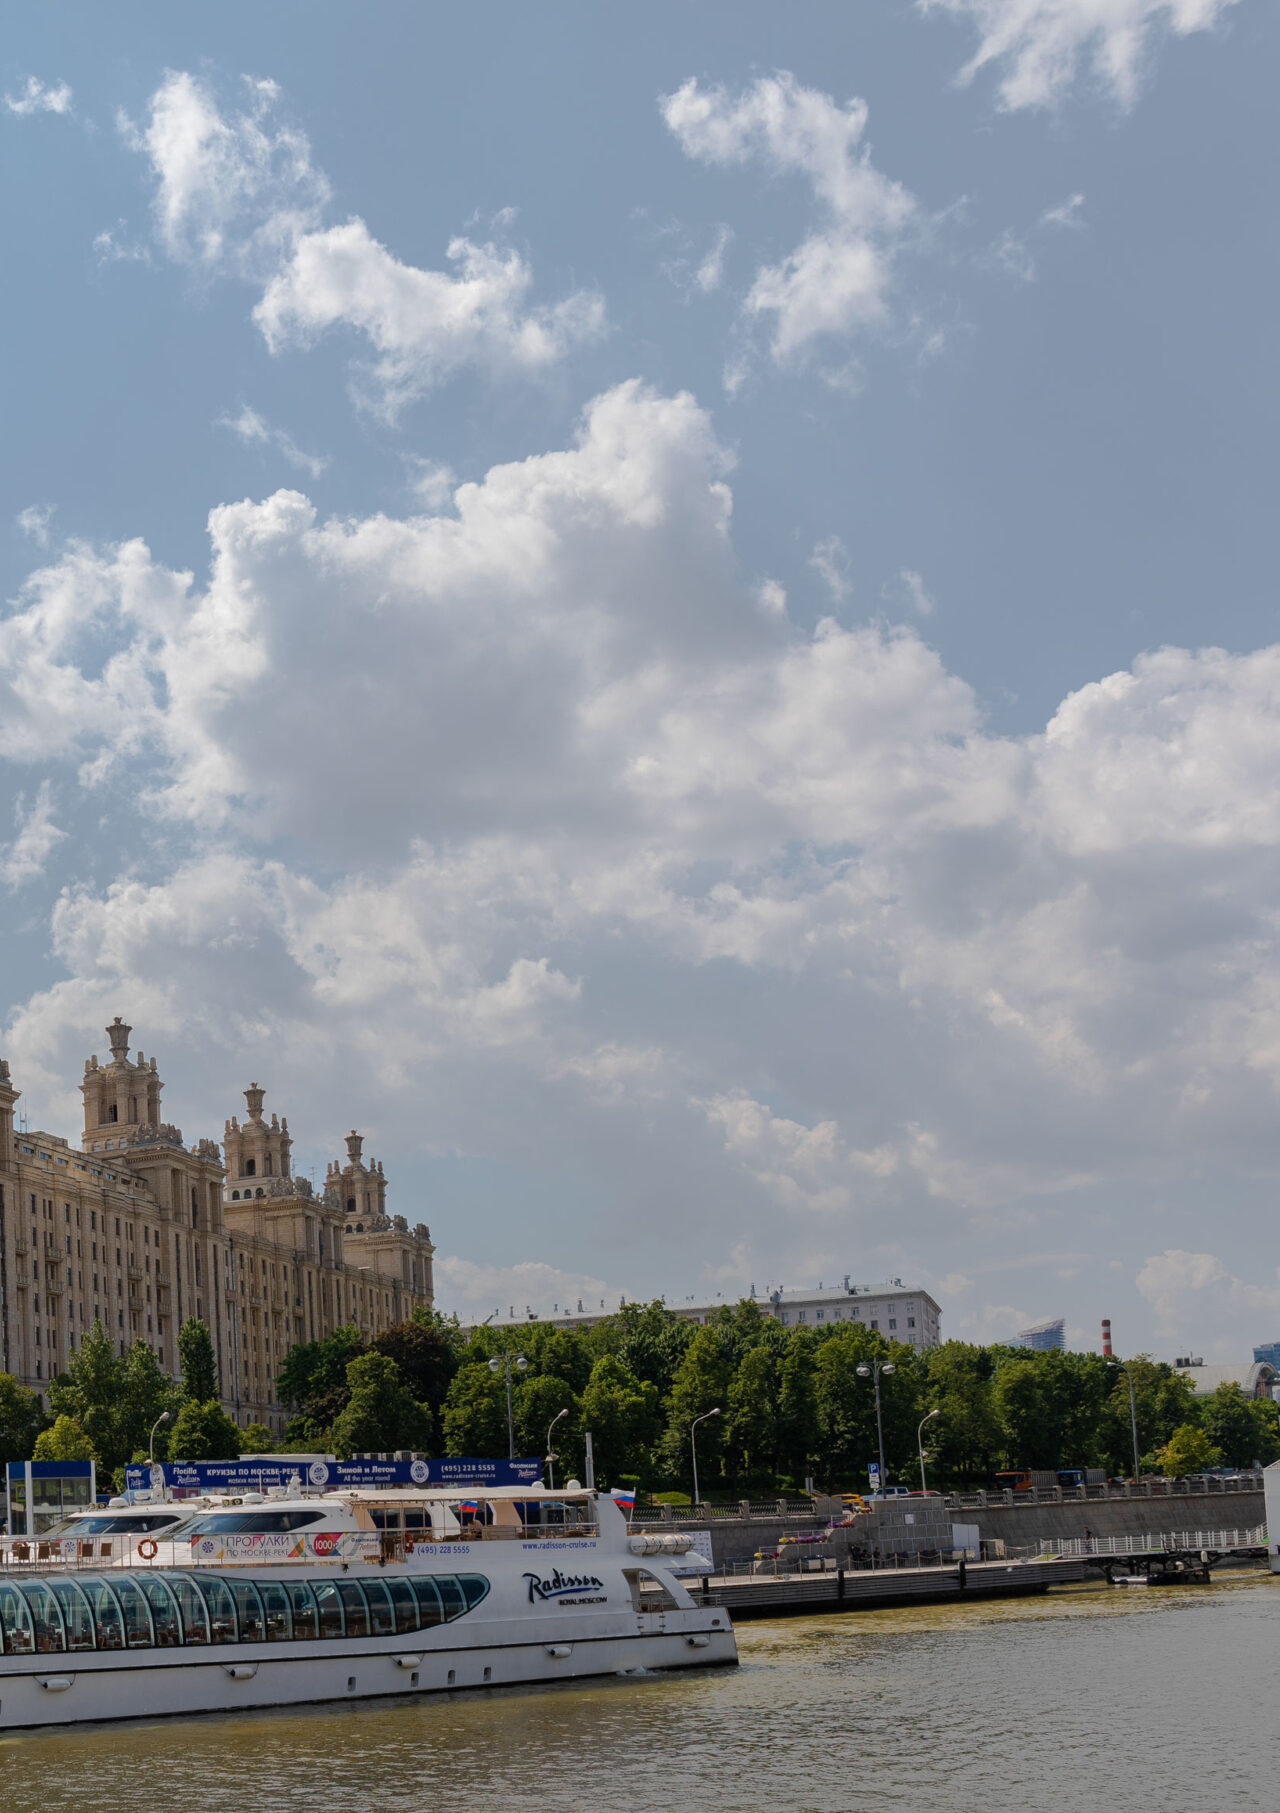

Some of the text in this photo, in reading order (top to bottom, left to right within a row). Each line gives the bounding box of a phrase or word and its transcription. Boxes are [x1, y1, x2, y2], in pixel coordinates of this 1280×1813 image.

[173, 1467, 198, 1476] Flotilla
[206, 1468, 237, 1477] КРУИЗЫ
[238, 1468, 249, 1476] ПО
[336, 1465, 363, 1474] Зимой
[371, 1465, 396, 1474] Летом
[441, 1464, 461, 1473] (495)
[462, 1464, 477, 1472] 228
[361, 1475, 374, 1483] year
[375, 1474, 390, 1482] round
[226, 1536, 289, 1547] ПРОГУЛКИ
[315, 1539, 333, 1550] 1000
[522, 1540, 597, 1550] www.radisson-cruise.ru
[226, 1549, 289, 1558] ПО МОСКВЕ-РЕКЕ
[417, 1545, 437, 1556] (495)
[439, 1546, 452, 1554] 228
[453, 1545, 470, 1554] 5555
[522, 1568, 604, 1605] Radisson
[558, 1597, 608, 1606] ROYAL MOSCOW
